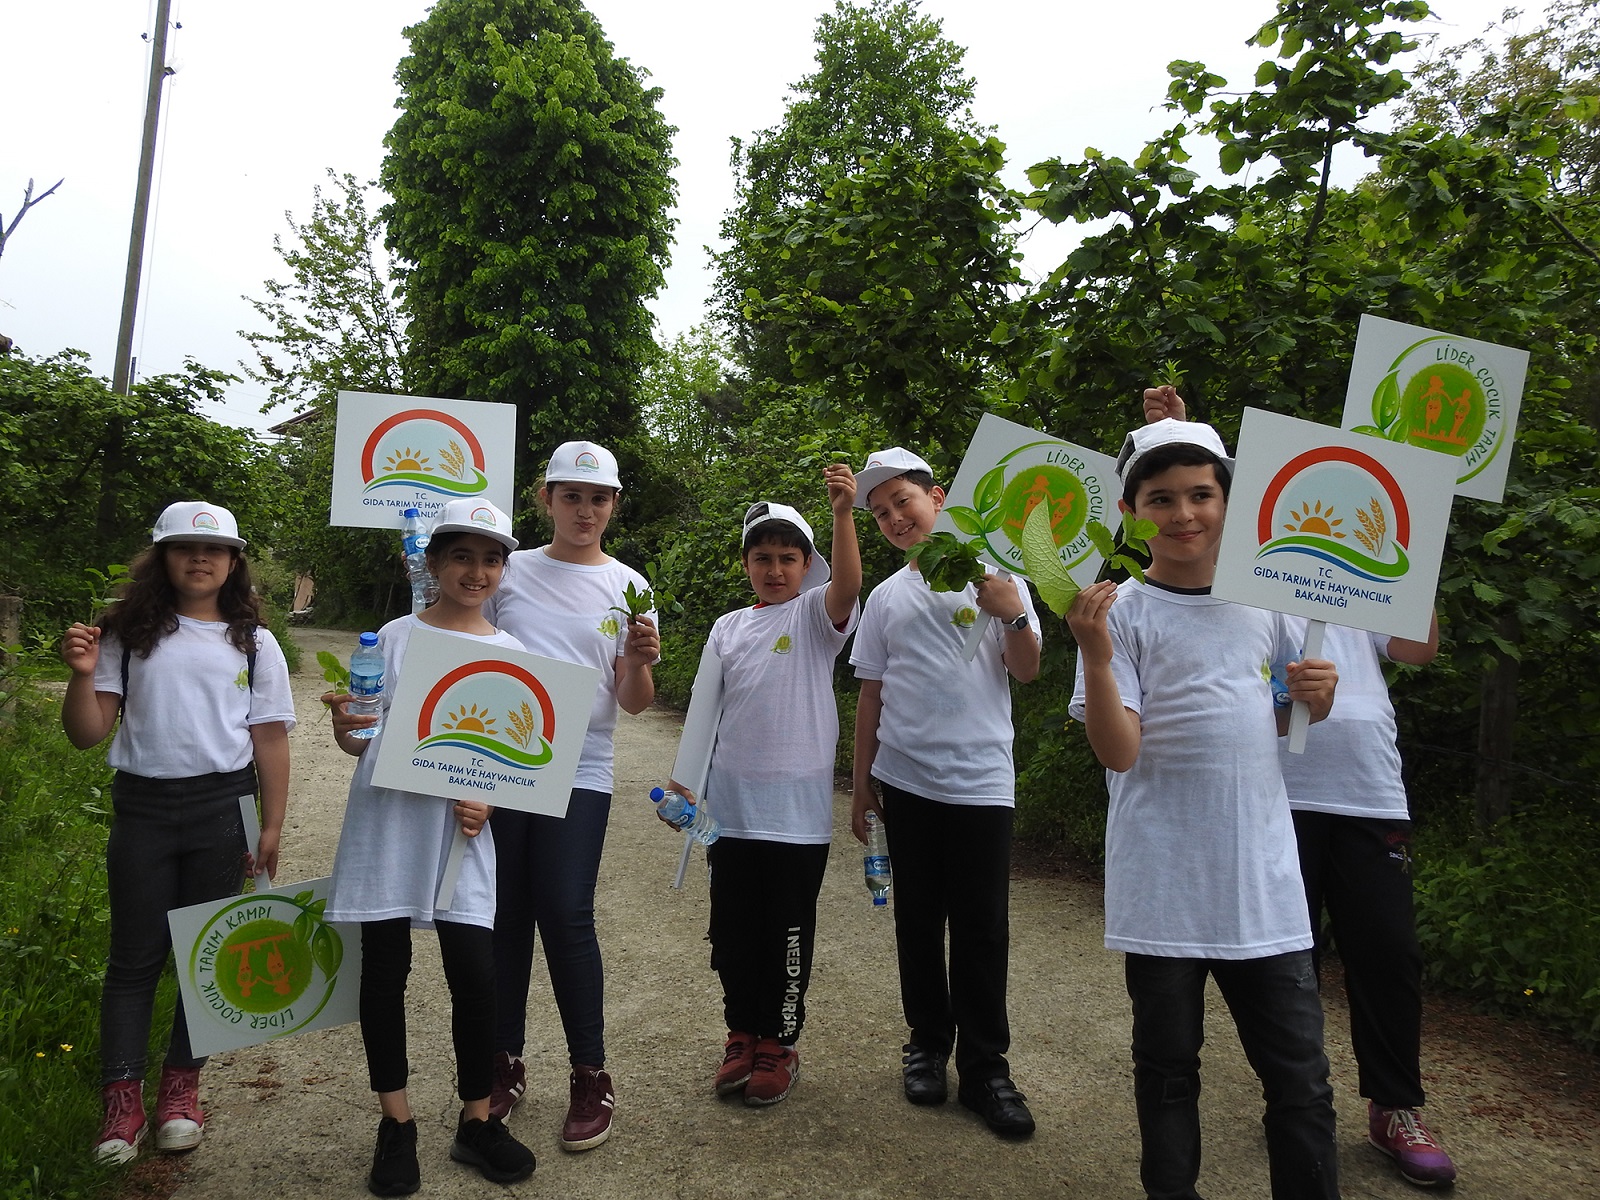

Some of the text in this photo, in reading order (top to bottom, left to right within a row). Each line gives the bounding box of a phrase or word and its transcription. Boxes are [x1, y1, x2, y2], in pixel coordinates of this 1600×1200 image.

[1436, 344, 1501, 467] LİDER ÇOCUK TARIM
[1046, 449, 1085, 476] LİDER
[362, 498, 384, 506] GIDA
[386, 499, 410, 508] TARIM
[412, 500, 422, 508] VE
[415, 492, 428, 500] T.C.
[1318, 566, 1333, 579] T.C.
[1254, 566, 1392, 604] GIDA TARIM VE HAYVANCILIK
[1294, 588, 1348, 608] BAKANLIĞI
[412, 758, 536, 788] GIDA TARIM VE HAYVANCILIK
[471, 757, 484, 768] T.C.
[448, 776, 496, 792] BAKANLIĞI
[786, 935, 801, 977] NEED
[200, 906, 294, 1030] LİDER ÇOCUK TARIM KAMPI
